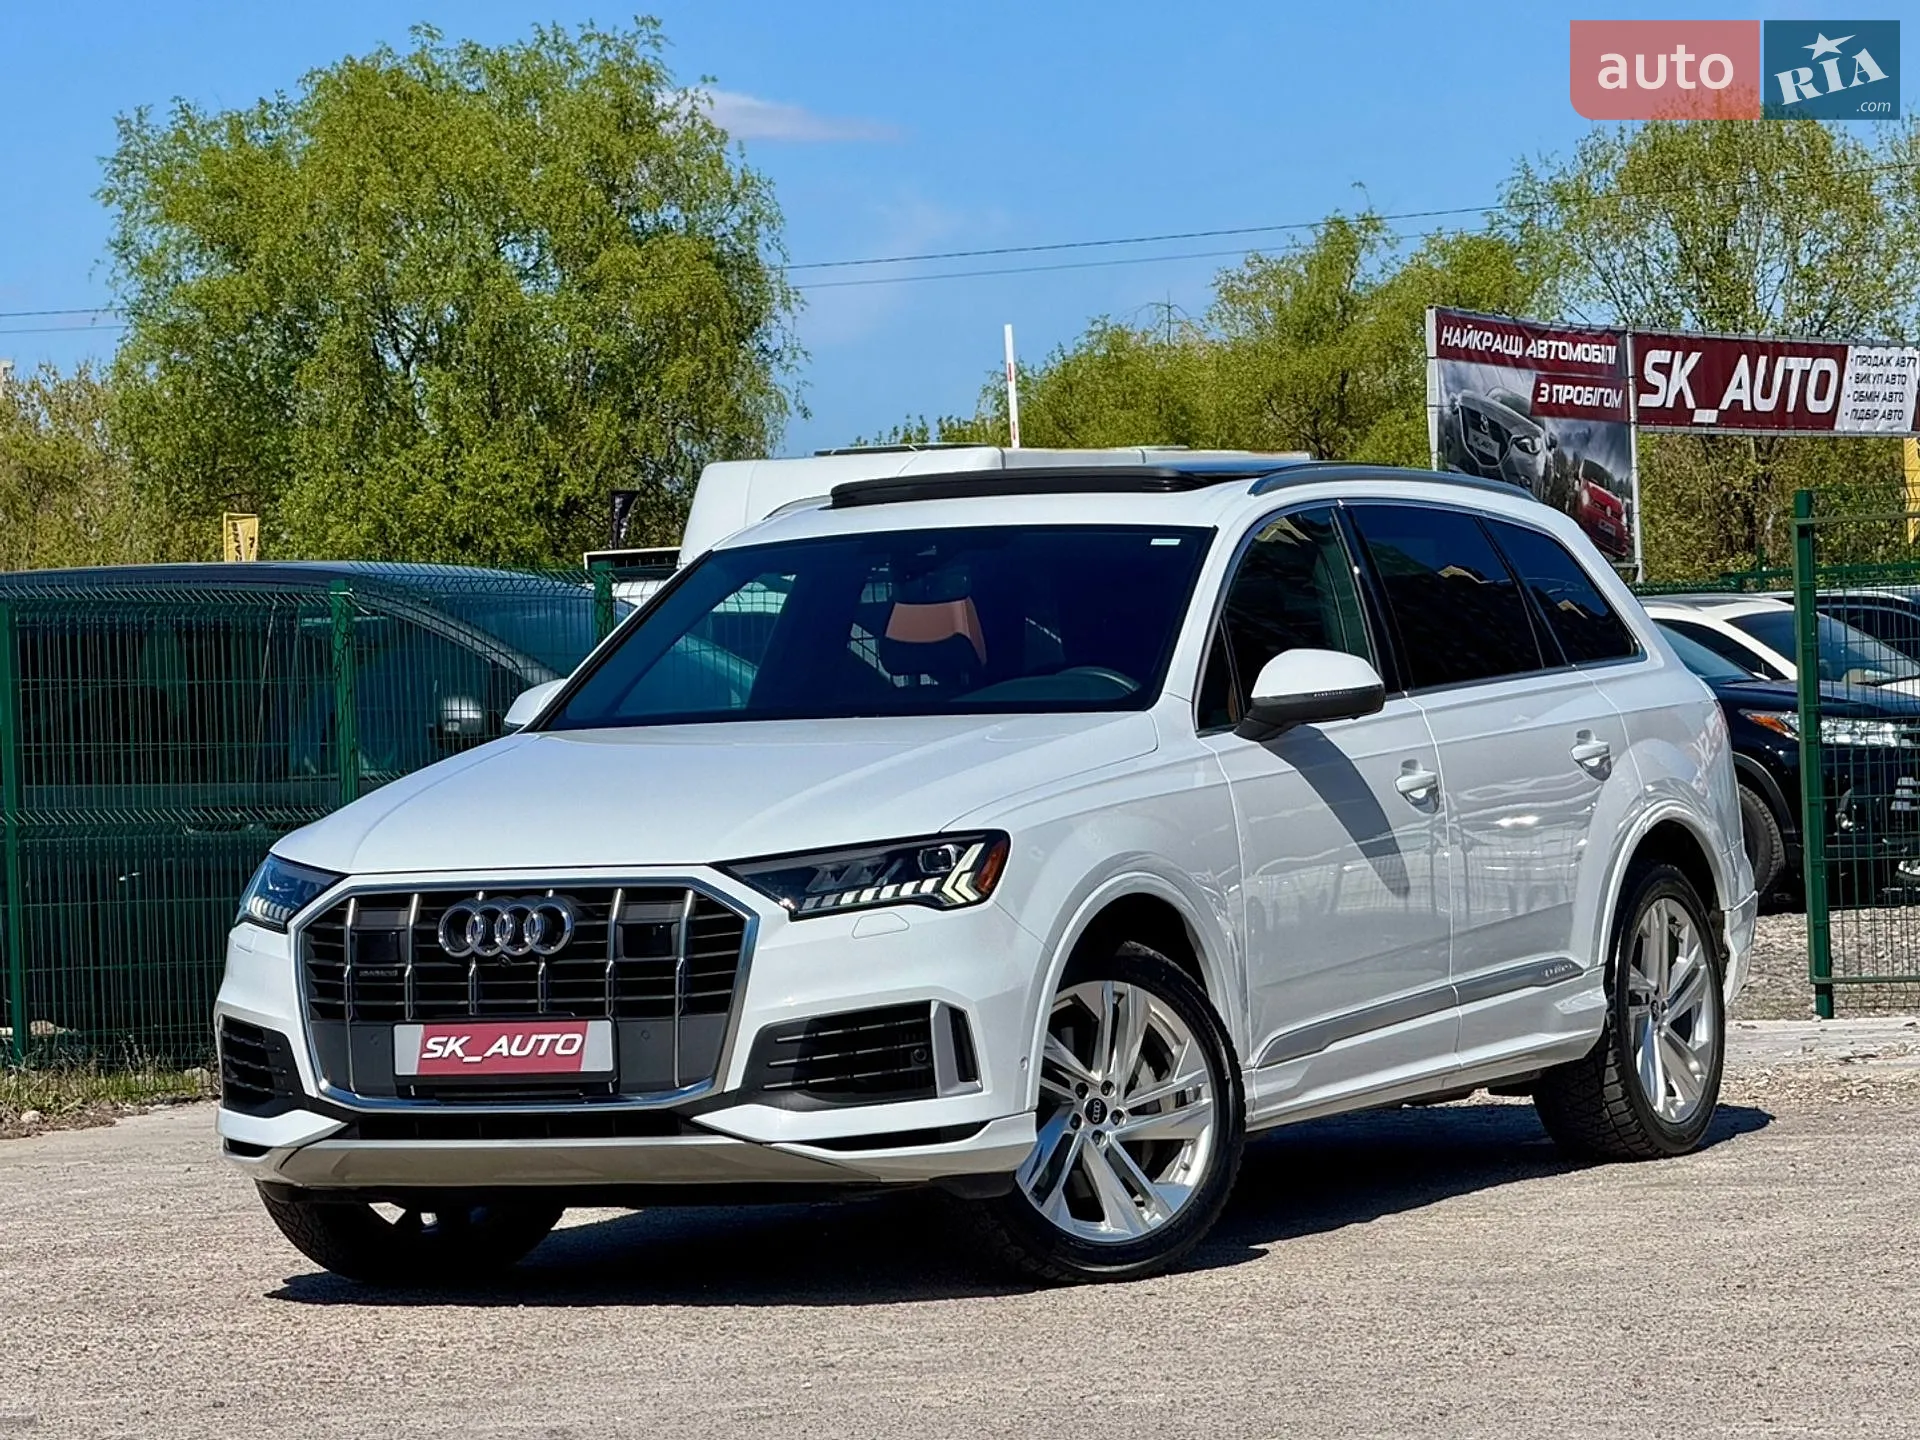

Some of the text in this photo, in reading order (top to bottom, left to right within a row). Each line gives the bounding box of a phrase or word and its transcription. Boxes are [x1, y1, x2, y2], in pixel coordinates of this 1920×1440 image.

[1440, 324, 1617, 365] НАЙКРАЩІ АВТОМОБІЛІ
[1638, 349, 1839, 424] SK_AUTO
[1854, 372, 1907, 386] ВИКУП АВТО
[1551, 384, 1623, 409] ПРОБІГОМ
[1881, 391, 1904, 403] АВТО
[1879, 409, 1904, 421] АВТО
[421, 1033, 584, 1063] SK_AUTO
